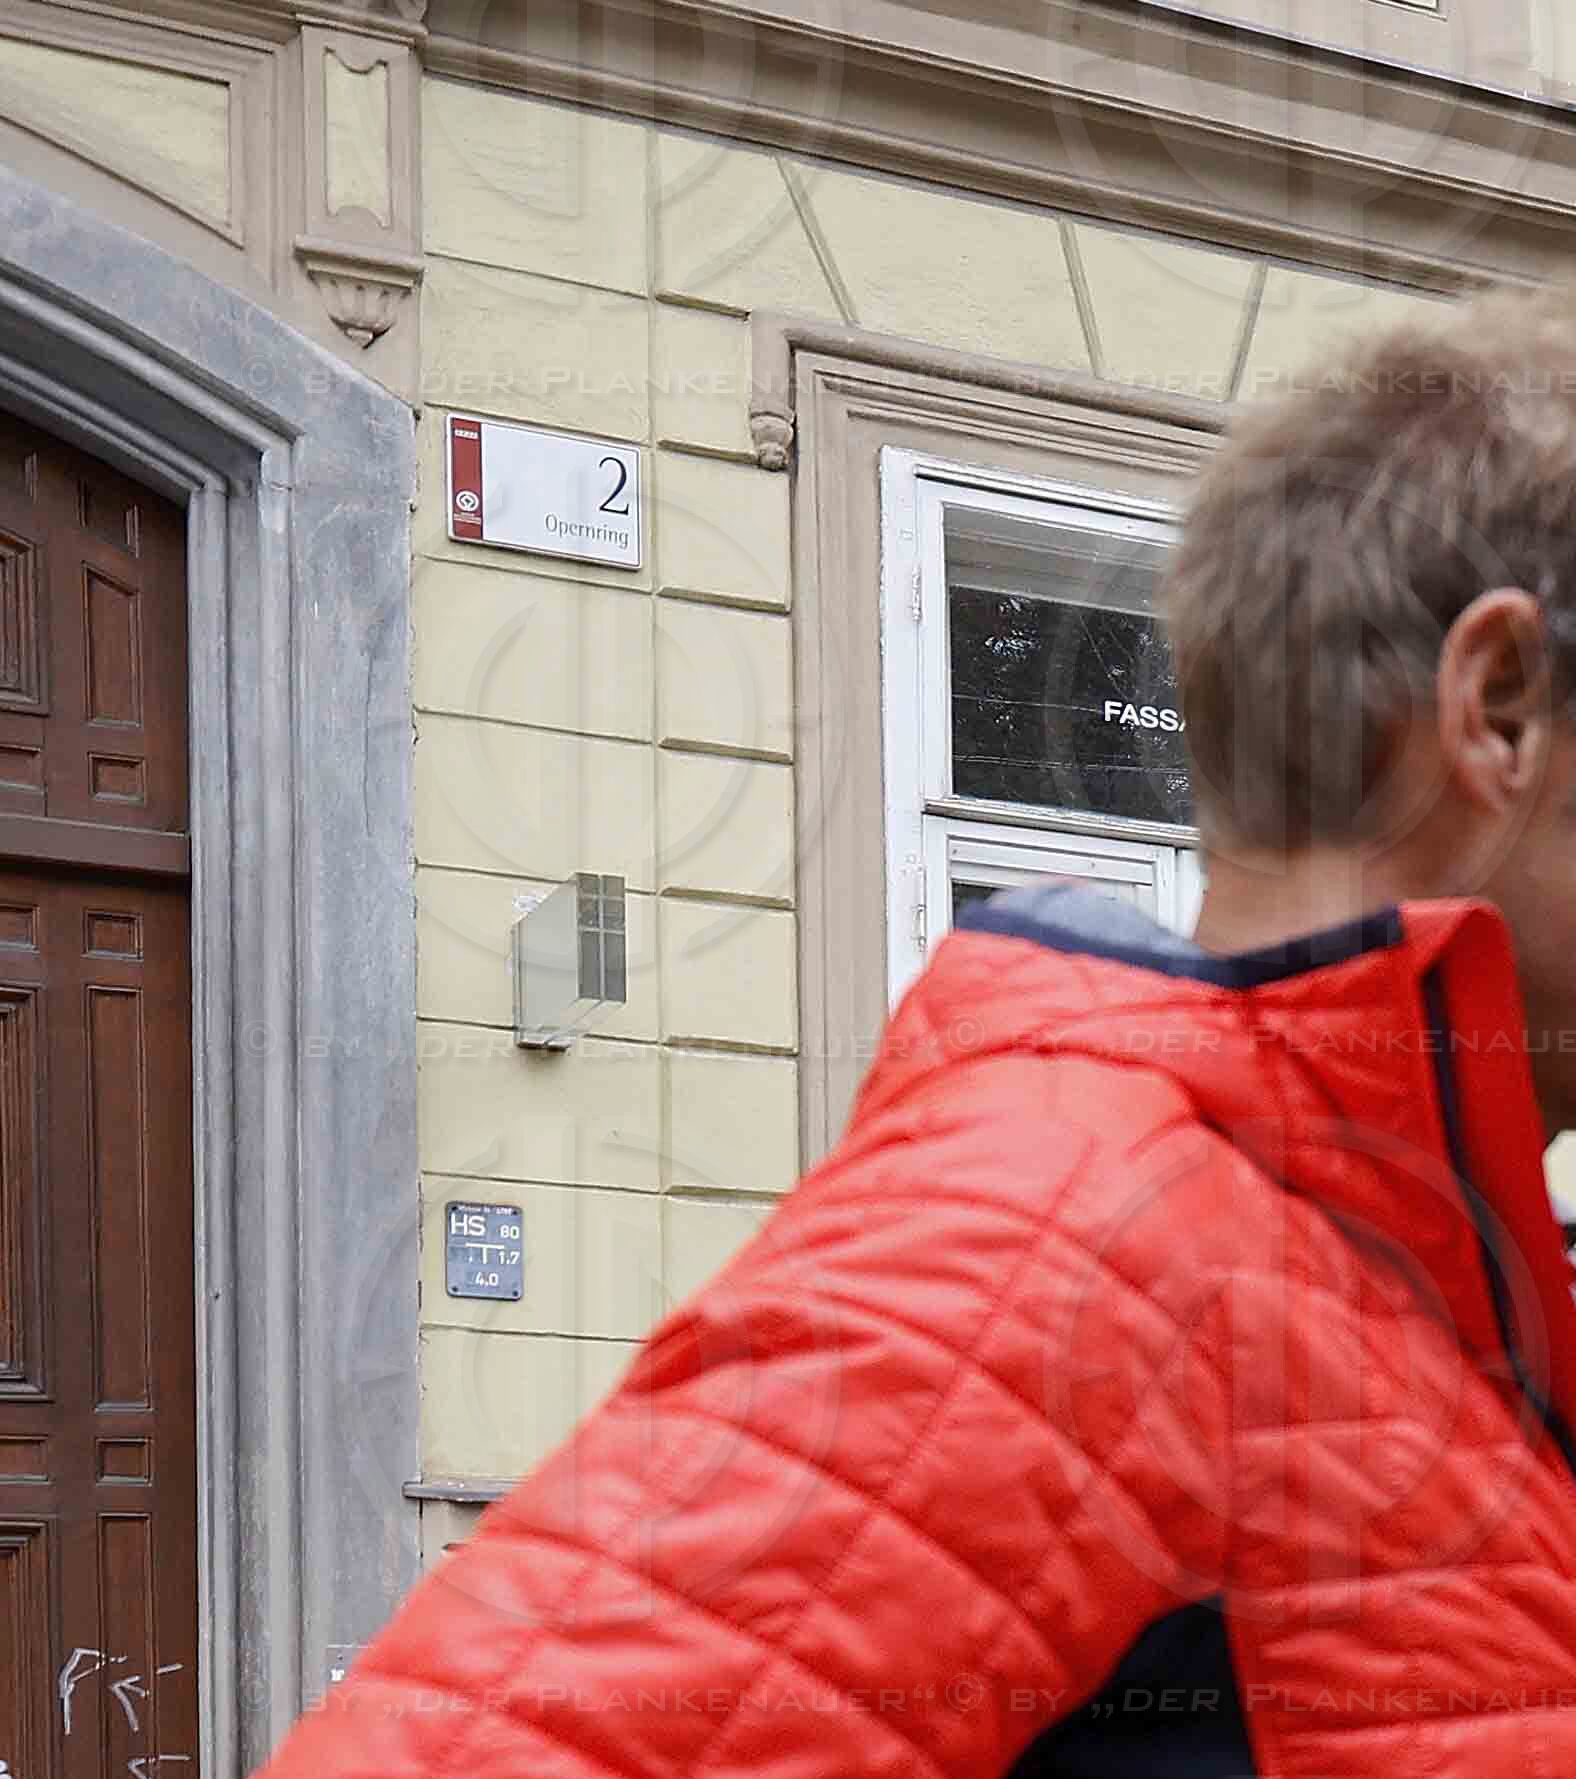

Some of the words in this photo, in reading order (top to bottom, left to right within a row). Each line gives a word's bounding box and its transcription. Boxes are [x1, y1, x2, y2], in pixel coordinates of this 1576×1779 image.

[598, 456, 630, 517] 2
[545, 513, 630, 550] Opernring
[1104, 700, 1186, 733] FASS
[450, 1212, 487, 1236] HS
